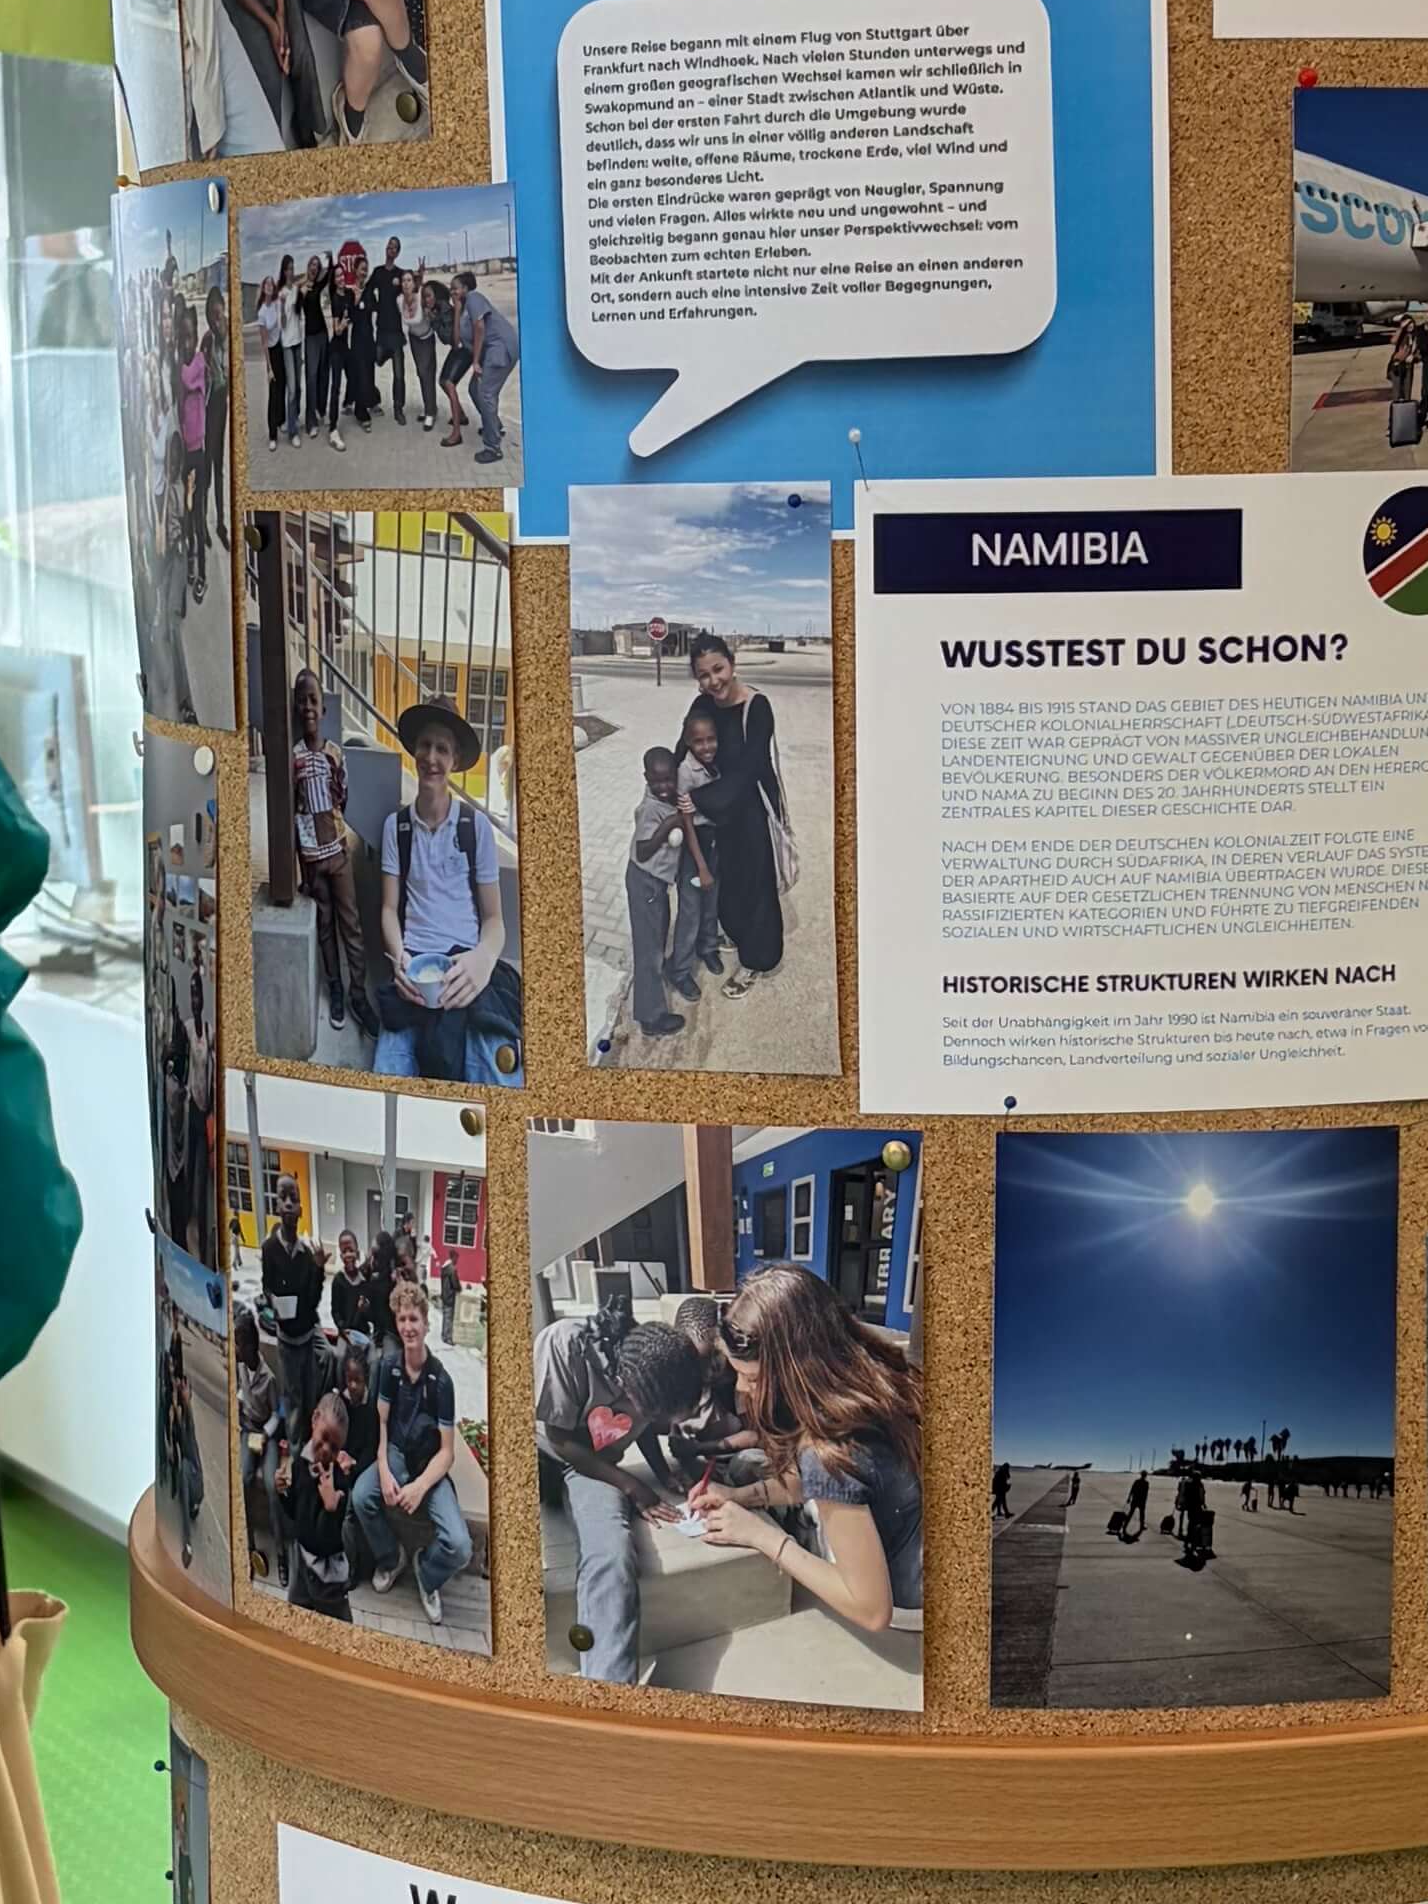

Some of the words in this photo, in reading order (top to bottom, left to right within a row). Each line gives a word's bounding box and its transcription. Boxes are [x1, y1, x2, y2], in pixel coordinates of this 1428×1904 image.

[971, 531, 1149, 568] NAMIBIA
[939, 638, 1126, 669] WUSSTEST
[1136, 637, 1186, 666] DU
[1198, 633, 1348, 665] SCHON?
[940, 702, 976, 716] VON
[979, 701, 1015, 716] 1884
[1018, 701, 1044, 715] BIS
[1046, 701, 1076, 715] 1915
[1078, 698, 1132, 715] STAND
[1135, 697, 1167, 714] DAS
[1170, 695, 1226, 713] GEBIET
[1228, 697, 1260, 712] DES
[1262, 695, 1338, 711] HEUTIGEN
[1341, 693, 1403, 707] NAMIBIA
[943, 975, 1090, 994] HISTORISCHE
[1096, 971, 1237, 993] STRUKTUREN
[1242, 967, 1328, 989] WIRKEN
[1335, 963, 1396, 985] NACH
